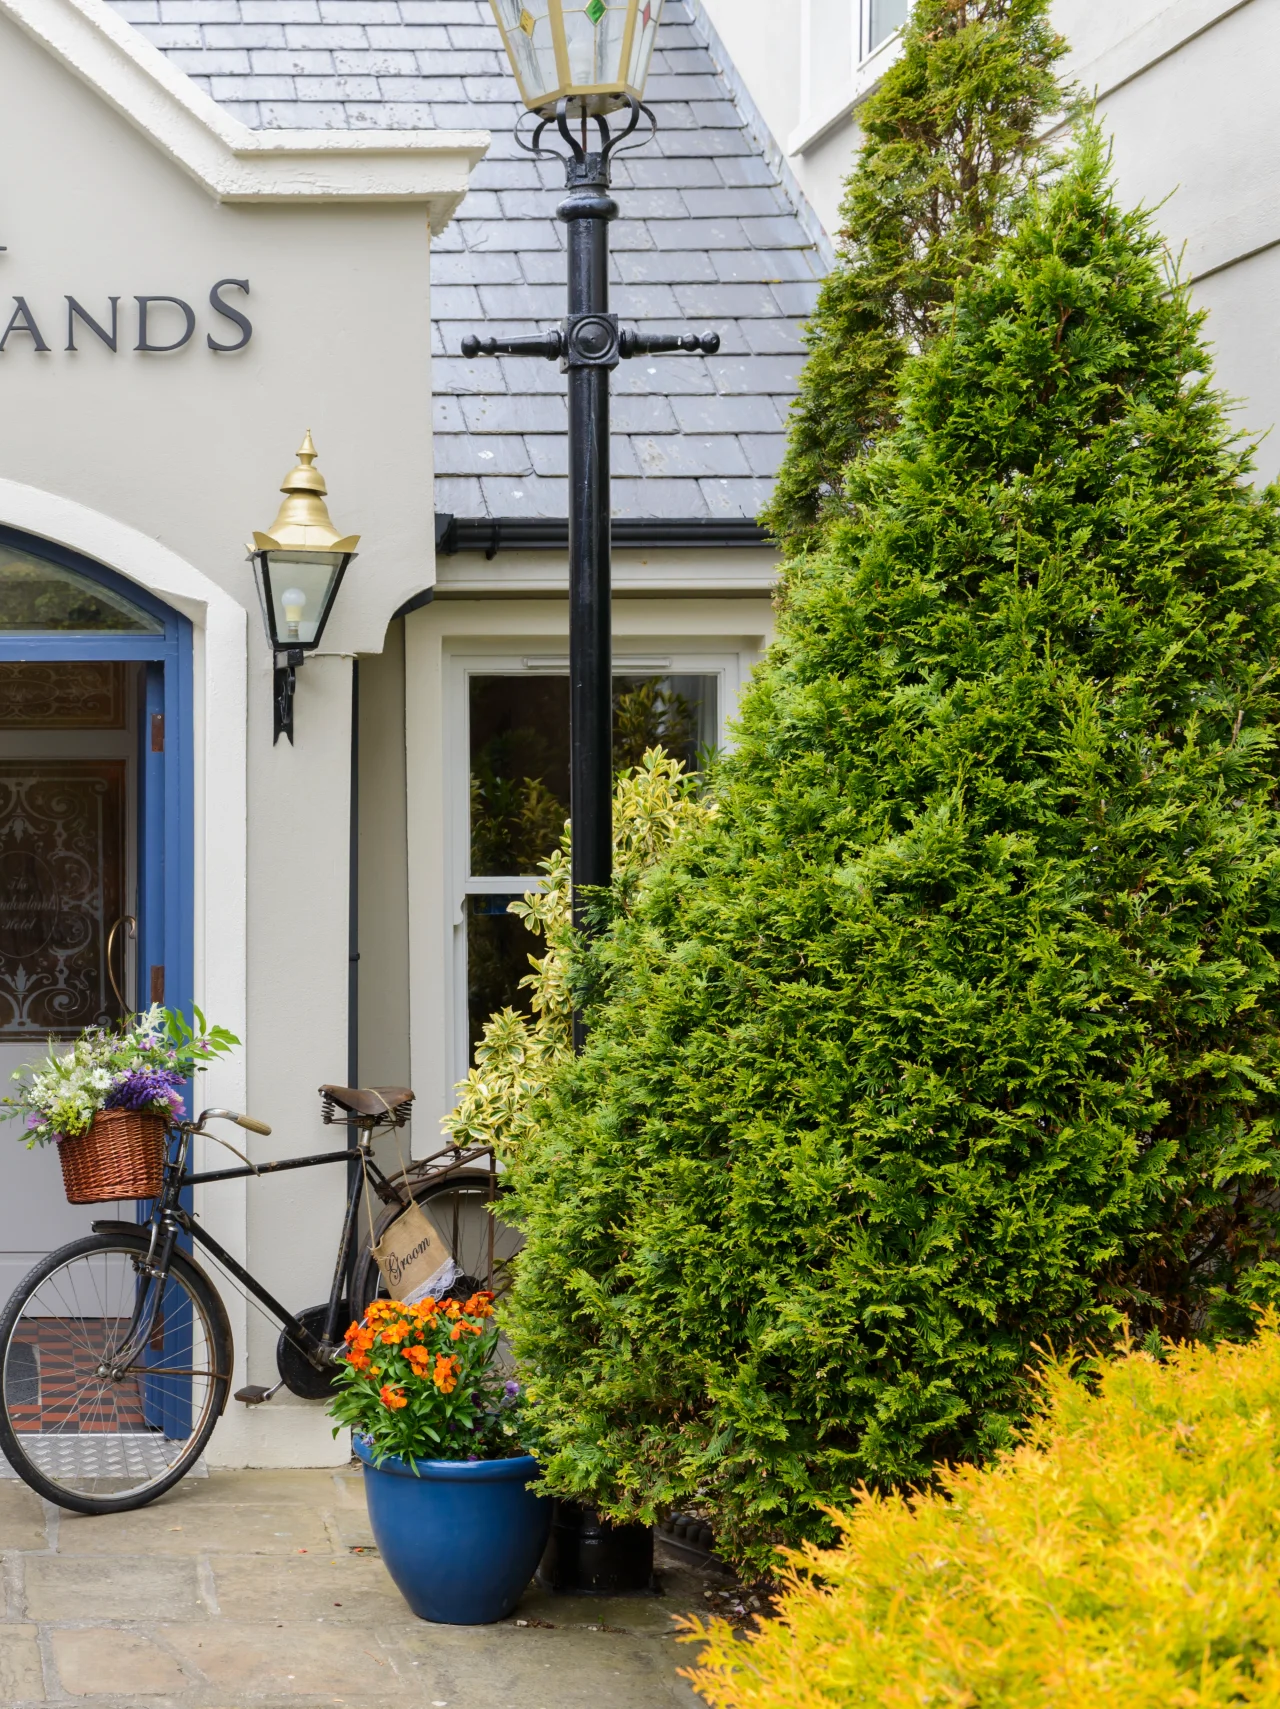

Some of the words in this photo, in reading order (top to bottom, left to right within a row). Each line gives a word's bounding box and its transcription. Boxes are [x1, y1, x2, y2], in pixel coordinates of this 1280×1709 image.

[7, 876, 28, 891] The
[1, 917, 37, 931] Hotel
[384, 1237, 431, 1287] Groom
